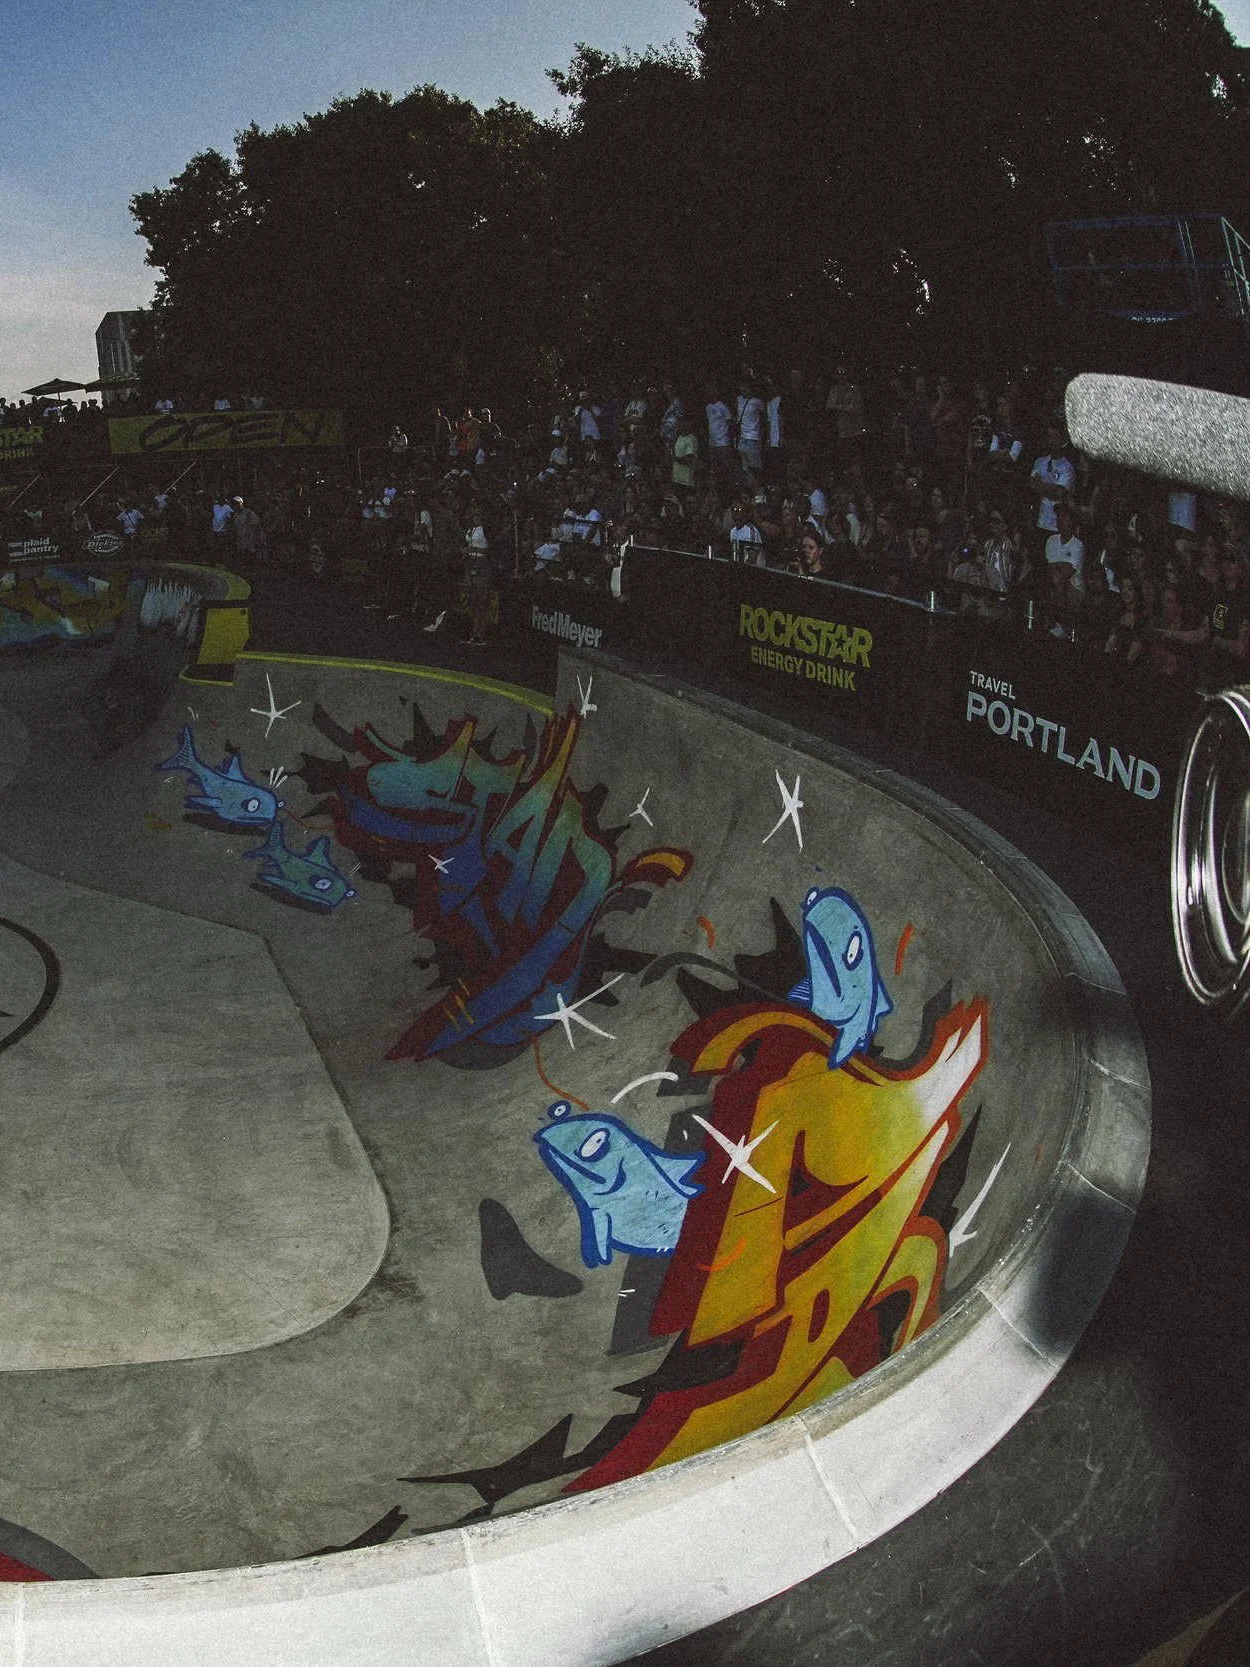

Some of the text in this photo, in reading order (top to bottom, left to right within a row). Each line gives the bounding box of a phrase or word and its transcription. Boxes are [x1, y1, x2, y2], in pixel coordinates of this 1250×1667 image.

[138, 412, 326, 450] OPEN
[23, 537, 50, 549] plaid
[23, 544, 59, 556] pantry
[739, 603, 873, 668] ROCKSTAR
[751, 644, 856, 692] ENERGY DRINK
[969, 670, 1016, 700] TRAVEL
[966, 690, 1162, 800] PORTLAND
